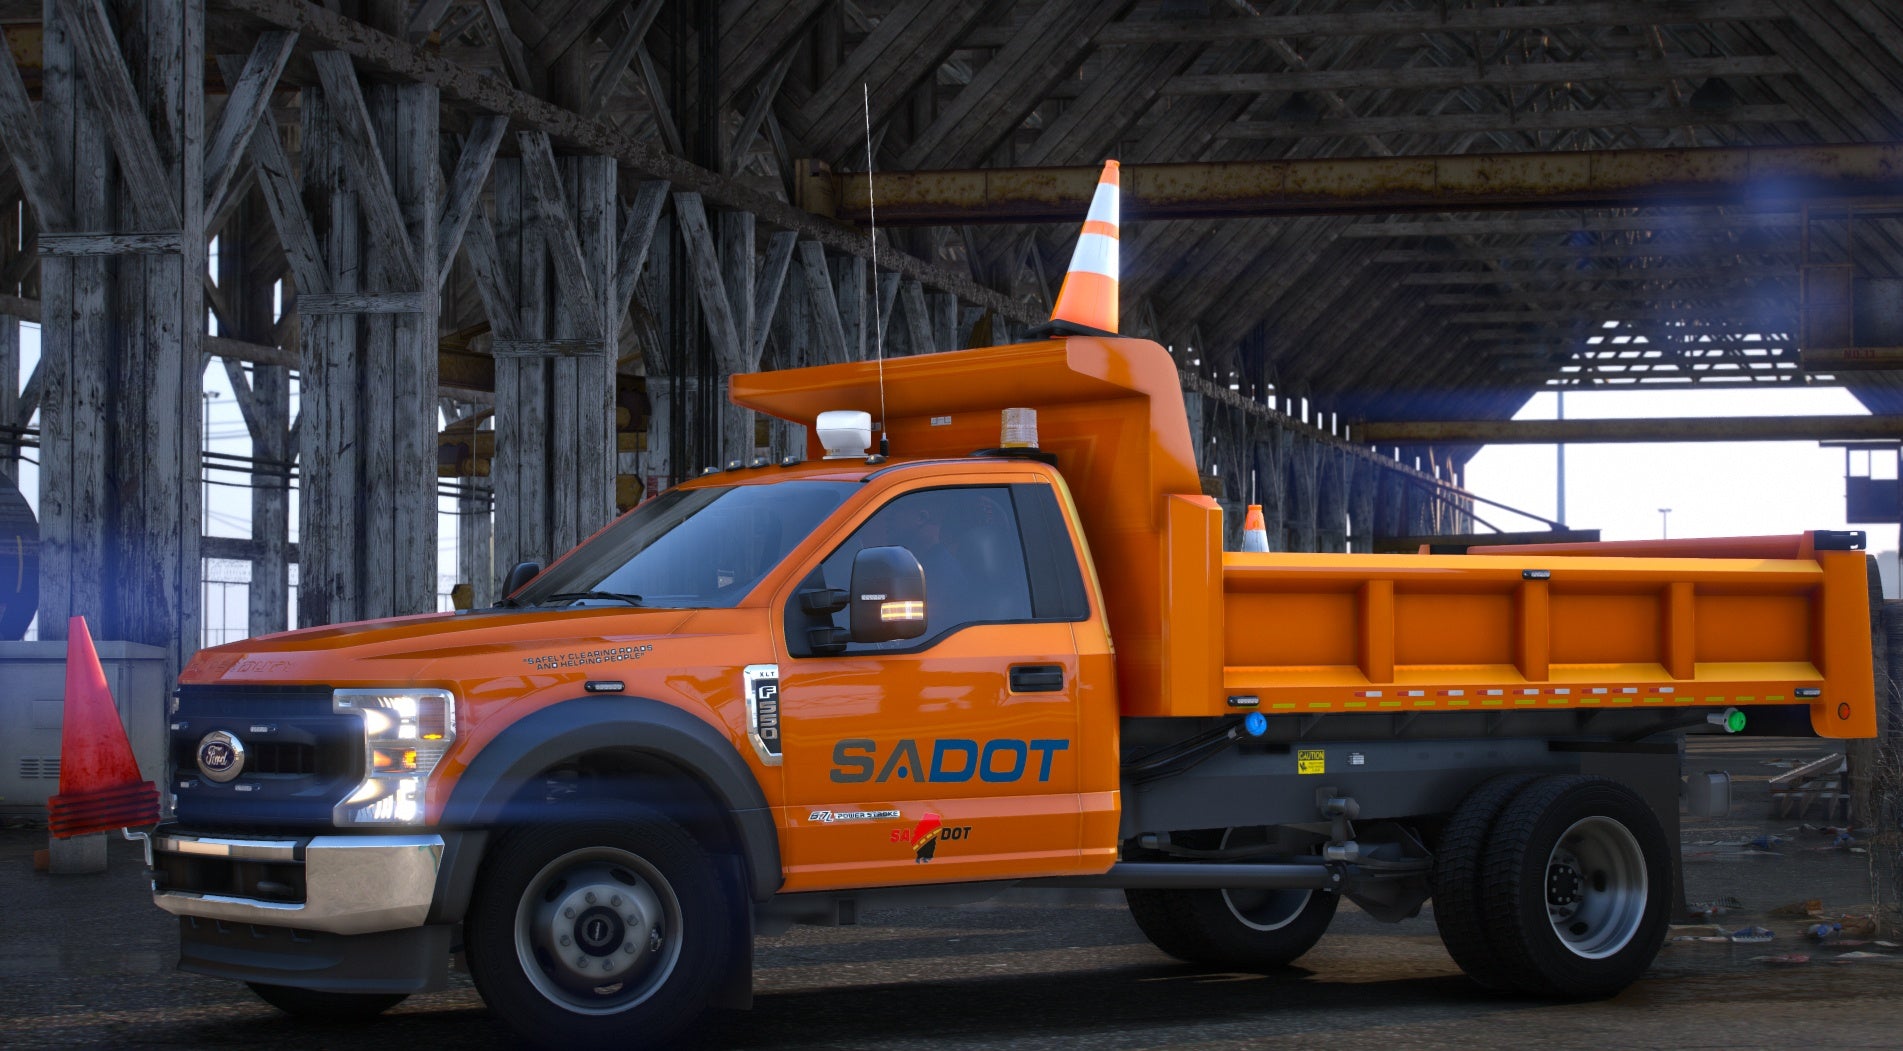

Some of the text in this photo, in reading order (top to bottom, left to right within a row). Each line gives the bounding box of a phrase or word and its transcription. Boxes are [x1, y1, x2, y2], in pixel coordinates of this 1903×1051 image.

[568, 648, 617, 660] CLEARING
[619, 644, 654, 655] ROADS
[537, 662, 559, 670] AND
[560, 658, 602, 667] HELPING
[205, 745, 229, 766] Ford
[830, 739, 1069, 783] SADOT
[1299, 751, 1324, 760] CAUTION
